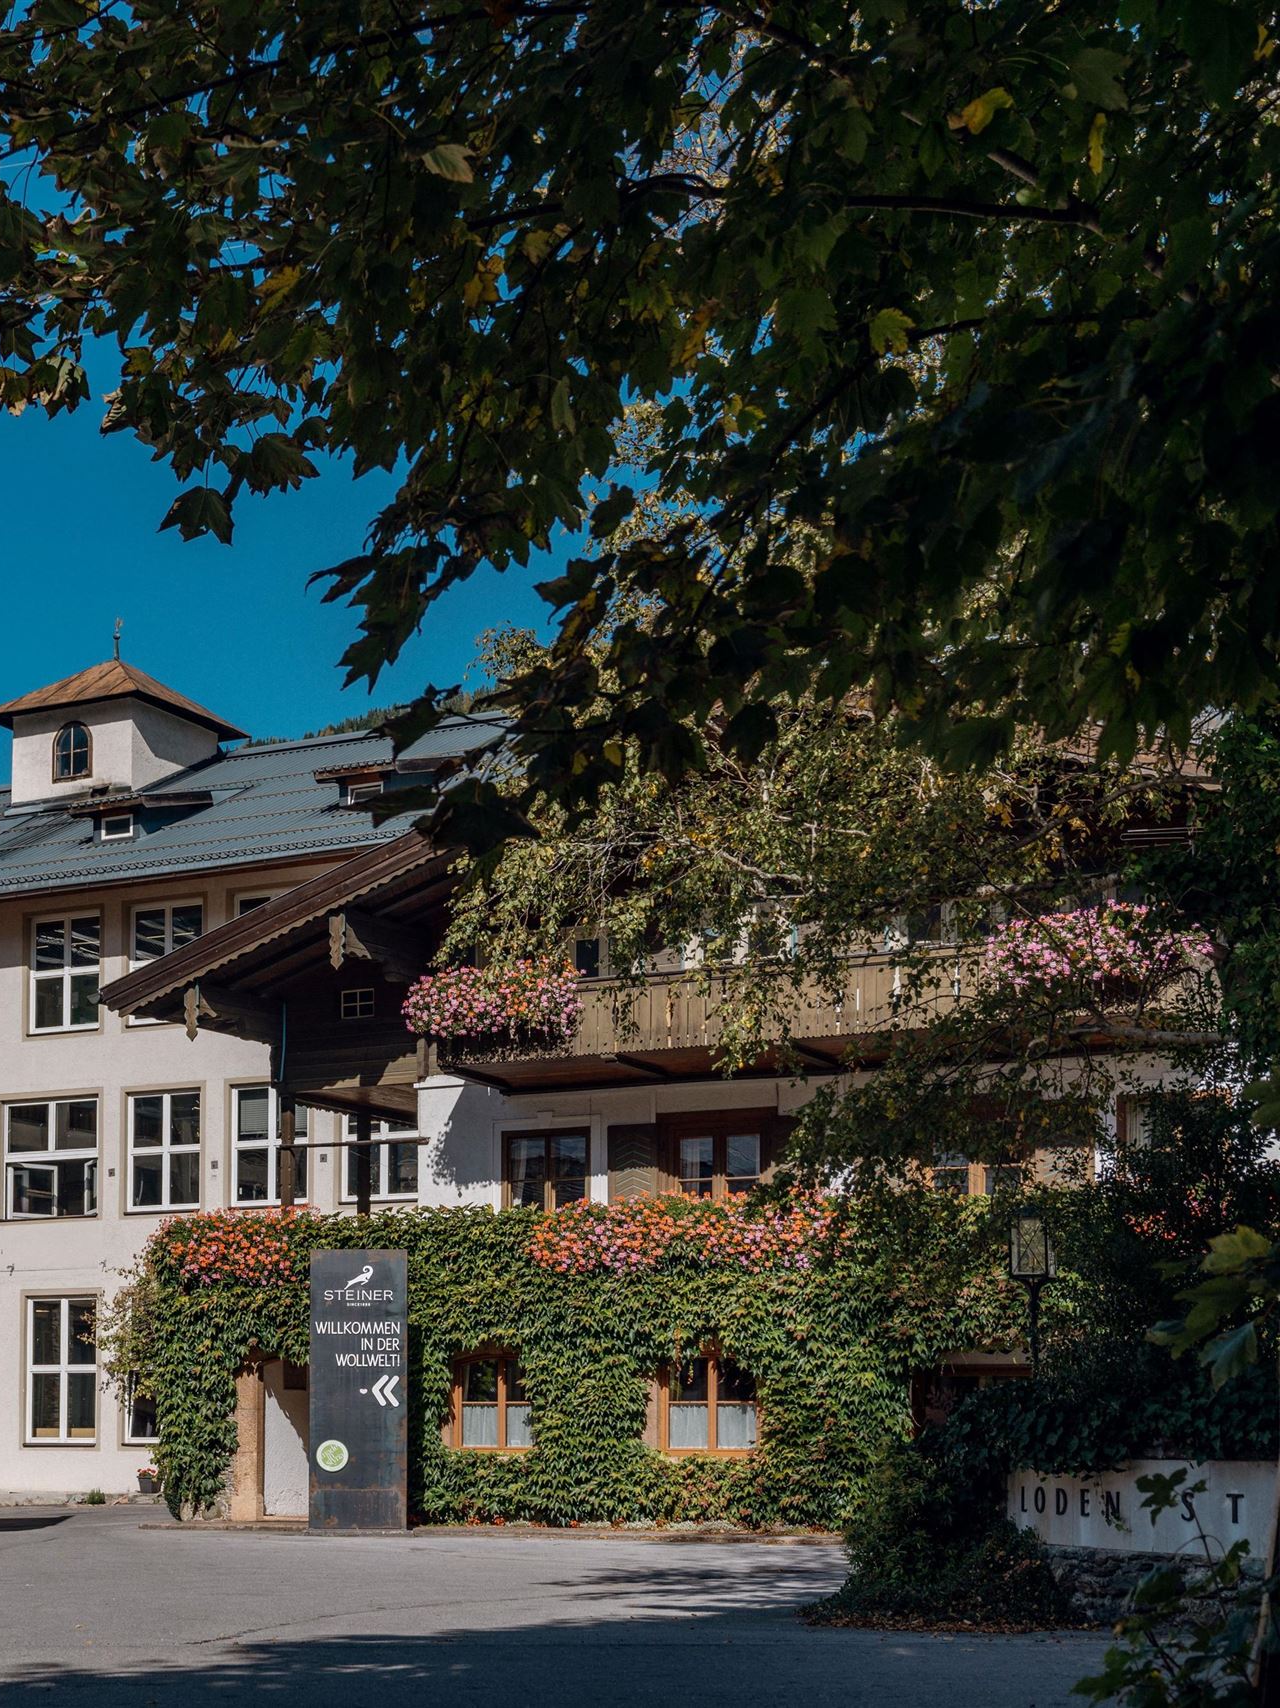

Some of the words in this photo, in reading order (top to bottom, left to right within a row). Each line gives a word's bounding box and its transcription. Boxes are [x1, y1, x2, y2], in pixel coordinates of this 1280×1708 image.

[324, 1289, 393, 1301] STEINER
[315, 1321, 400, 1335] WILLKOMMEN
[361, 1338, 373, 1351] IN
[377, 1338, 400, 1351] DER
[335, 1353, 400, 1367] WOLLWELT!
[1021, 1486, 1120, 1519] LODEN
